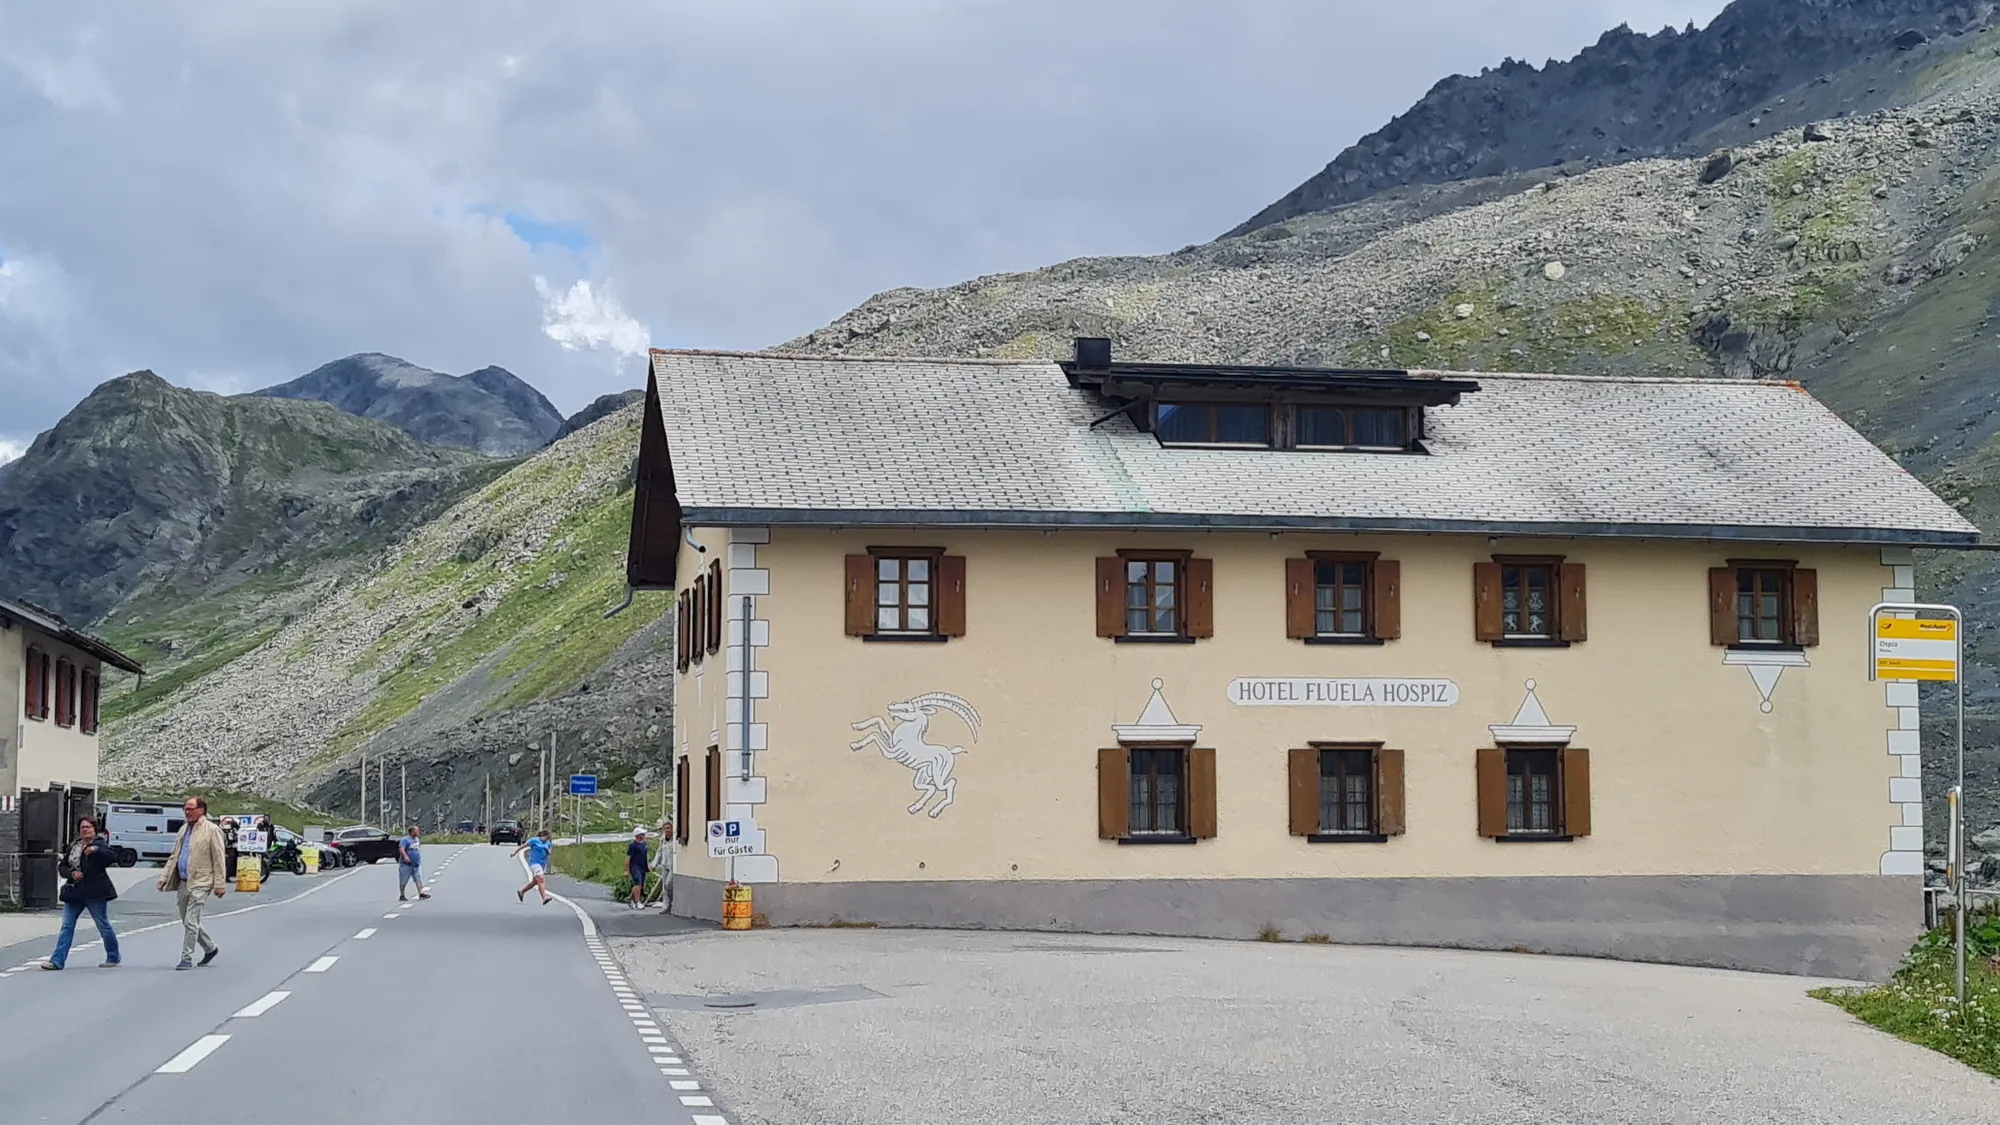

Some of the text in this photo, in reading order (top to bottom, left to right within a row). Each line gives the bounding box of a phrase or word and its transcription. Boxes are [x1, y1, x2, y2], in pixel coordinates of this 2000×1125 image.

[1239, 681, 1299, 701] HOTEL
[1383, 682, 1448, 703] HOSPIZ
[713, 845, 754, 856] für Gäste
